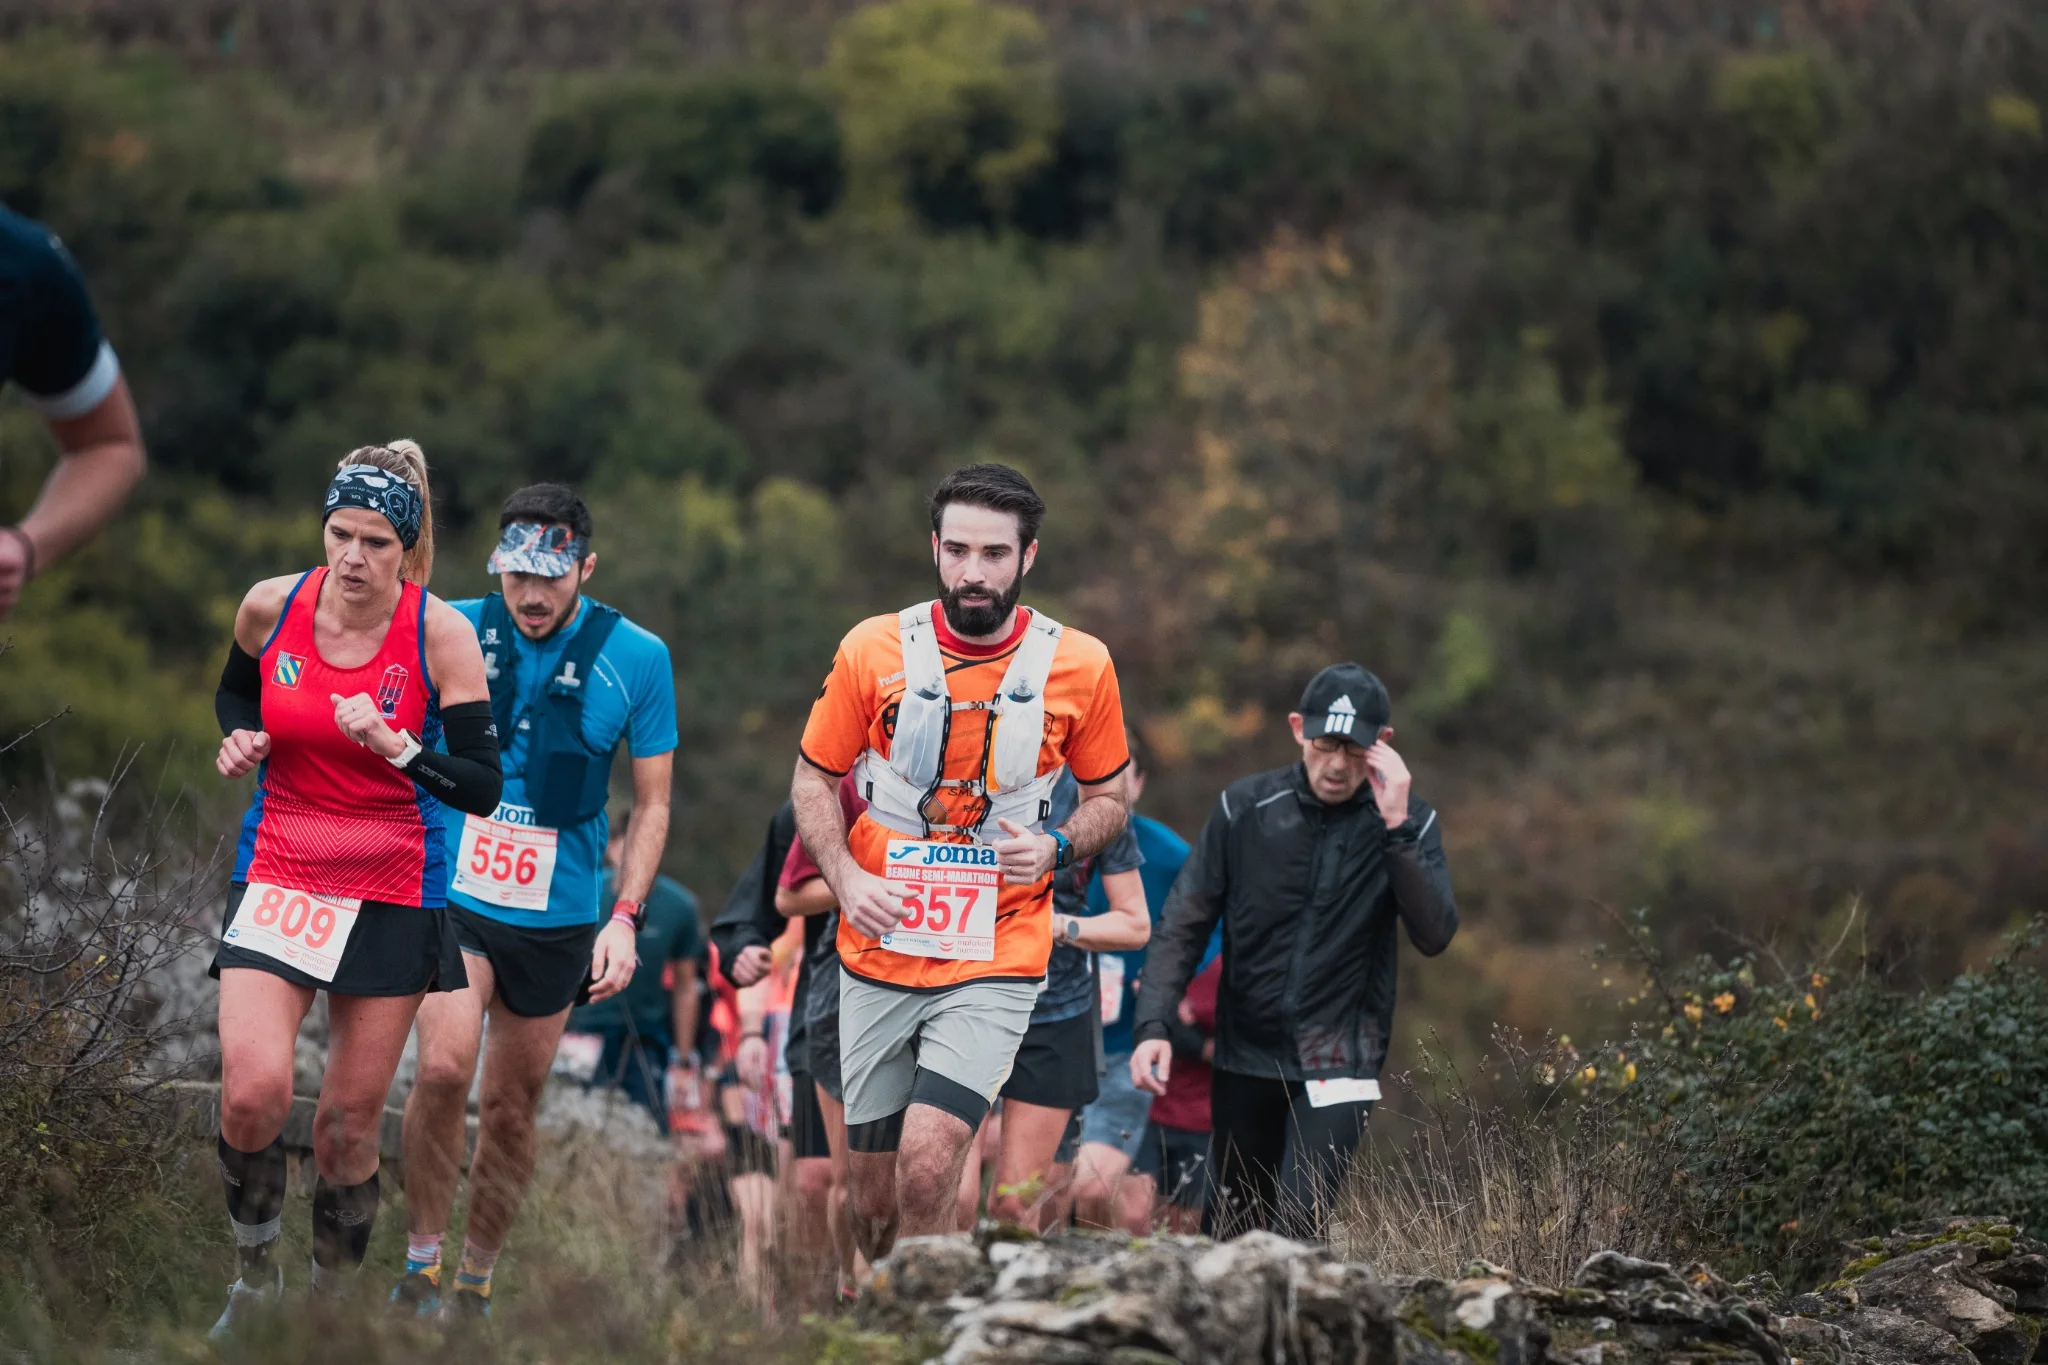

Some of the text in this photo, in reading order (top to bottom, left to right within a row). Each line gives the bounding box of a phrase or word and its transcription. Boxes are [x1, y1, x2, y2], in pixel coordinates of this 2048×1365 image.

[380, 686, 402, 699] DUC
[494, 805, 535, 825] Jom
[471, 835, 538, 885] 556
[886, 866, 998, 885] BEAUNE SEMI-MARATHON
[253, 887, 336, 949] 809
[900, 883, 980, 934] 557
